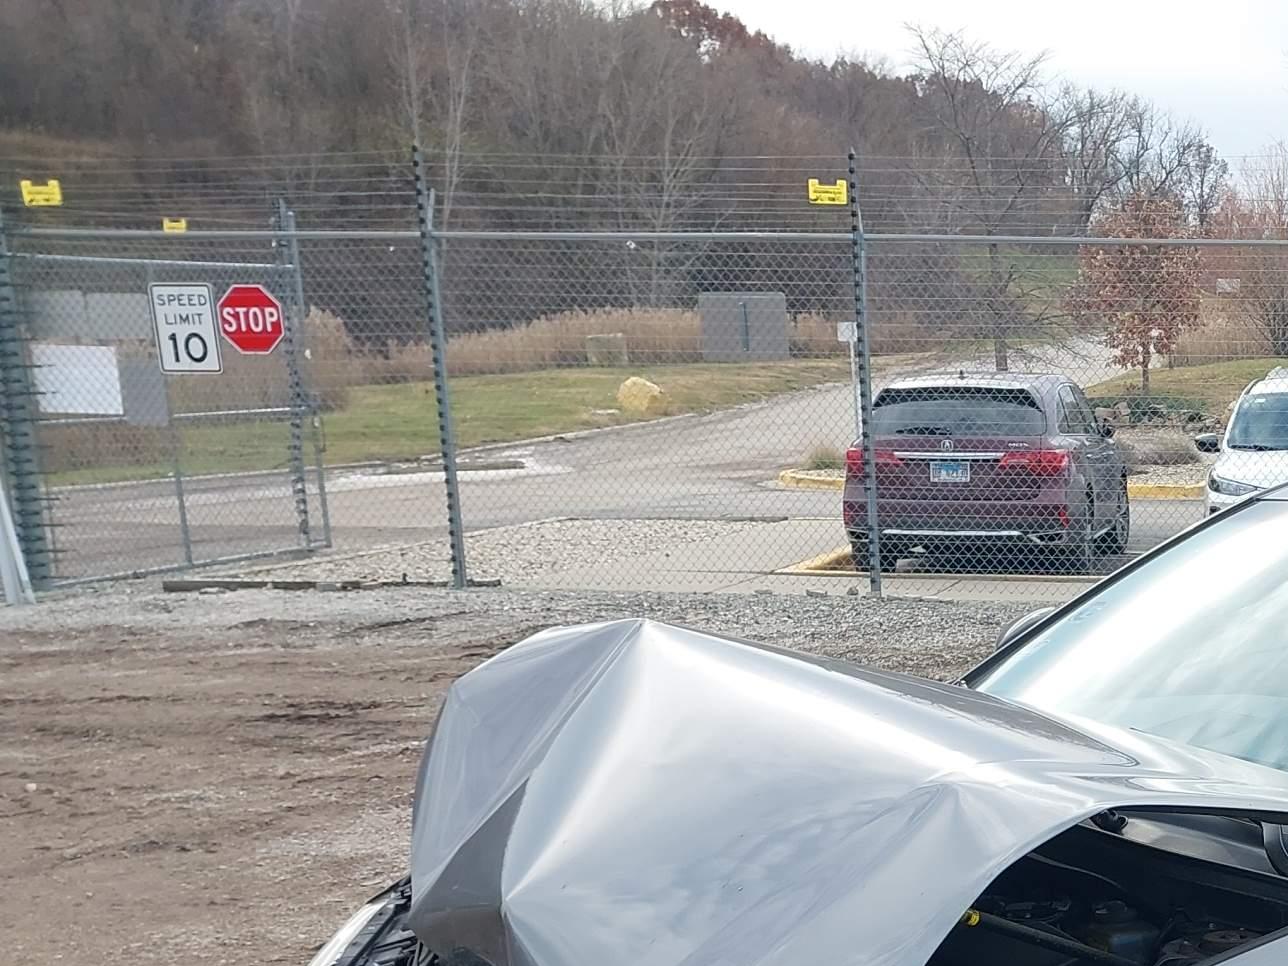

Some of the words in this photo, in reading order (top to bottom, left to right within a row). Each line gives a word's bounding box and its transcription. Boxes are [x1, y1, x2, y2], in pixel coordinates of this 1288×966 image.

[156, 294, 207, 306] SPEED
[164, 313, 204, 326] LIMIT
[222, 307, 278, 333] STOP
[168, 332, 208, 363] 10
